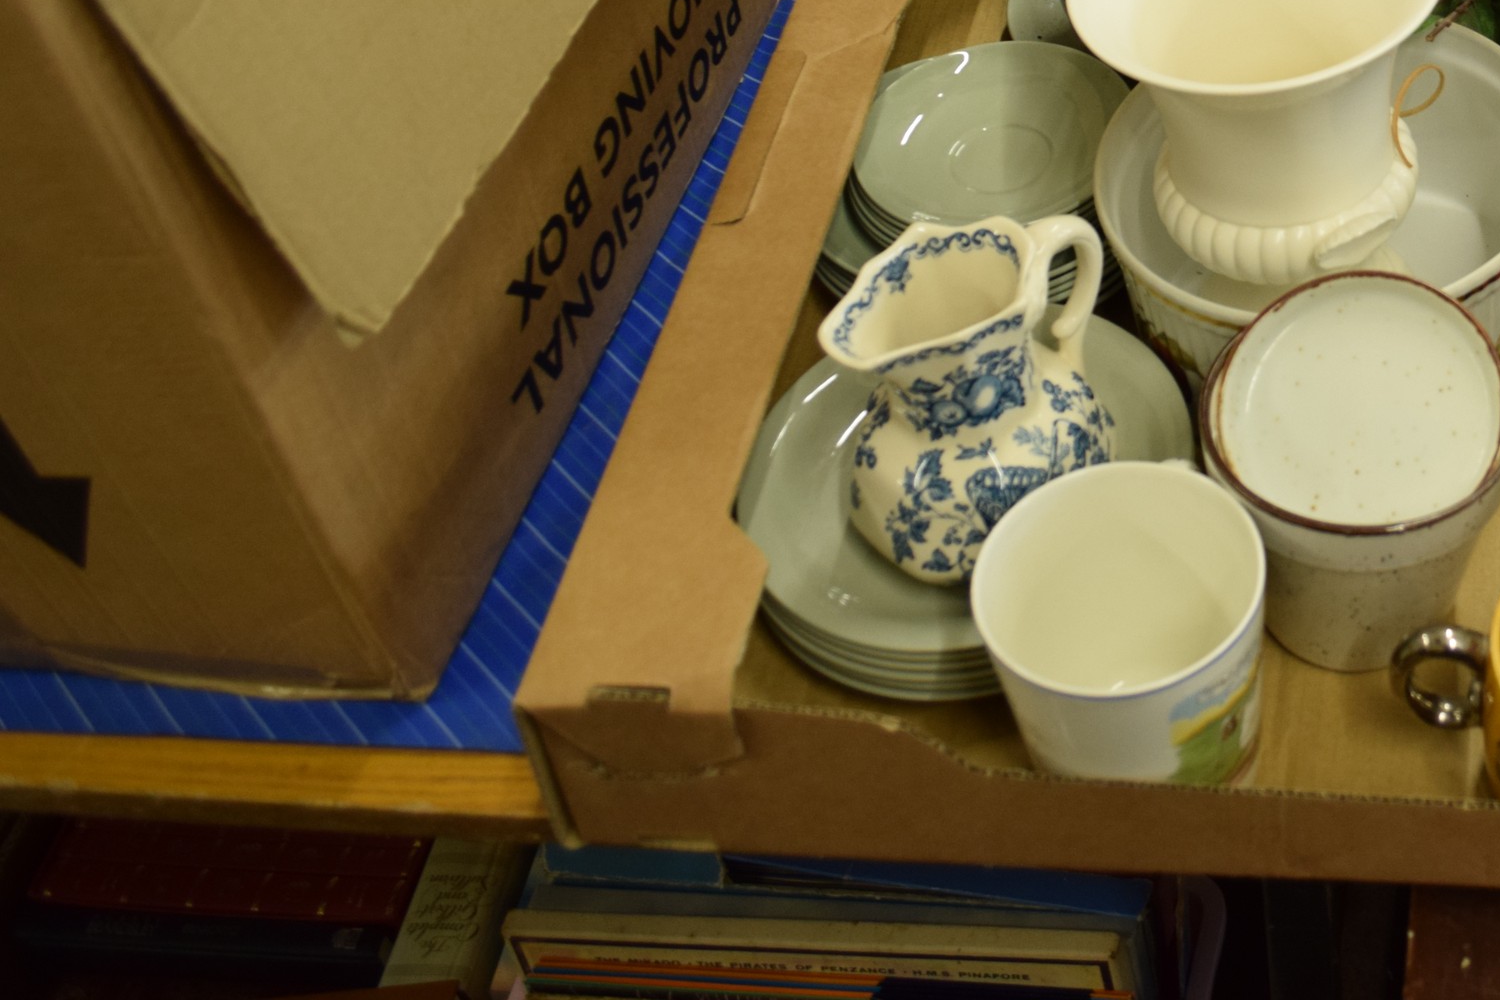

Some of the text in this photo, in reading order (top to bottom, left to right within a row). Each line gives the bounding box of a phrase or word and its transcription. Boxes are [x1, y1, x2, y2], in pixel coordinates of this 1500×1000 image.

[505, 166, 593, 332] BOX
[696, 960, 723, 969] THE
[730, 962, 786, 971] PIRATES
[821, 965, 896, 975] PENZANCE
[958, 970, 1032, 981] PINAFORE
